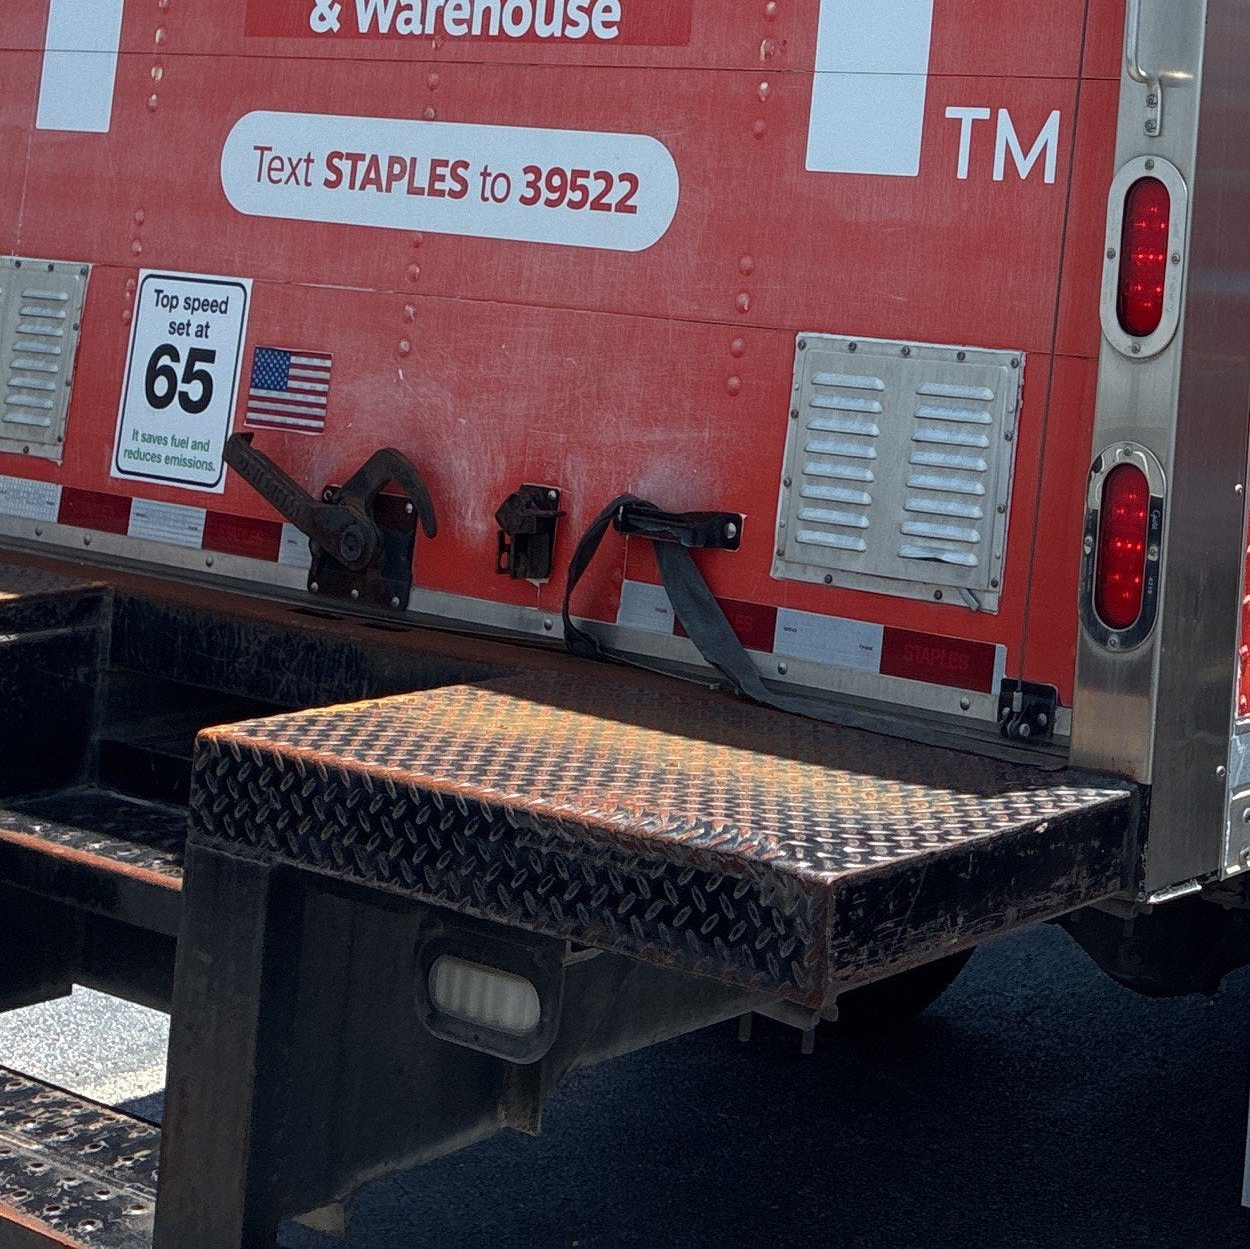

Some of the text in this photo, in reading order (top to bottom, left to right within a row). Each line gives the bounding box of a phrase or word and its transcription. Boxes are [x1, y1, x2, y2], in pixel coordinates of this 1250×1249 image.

[944, 105, 1061, 184] TM
[253, 145, 640, 215] Text STAPLES to 39522
[153, 288, 230, 315] Top speed
[168, 319, 211, 339] set at
[144, 342, 217, 415] 65
[131, 428, 210, 452] It saves fuel and
[123, 449, 216, 473] reduces emissions.
[904, 642, 971, 673] STAPLES
